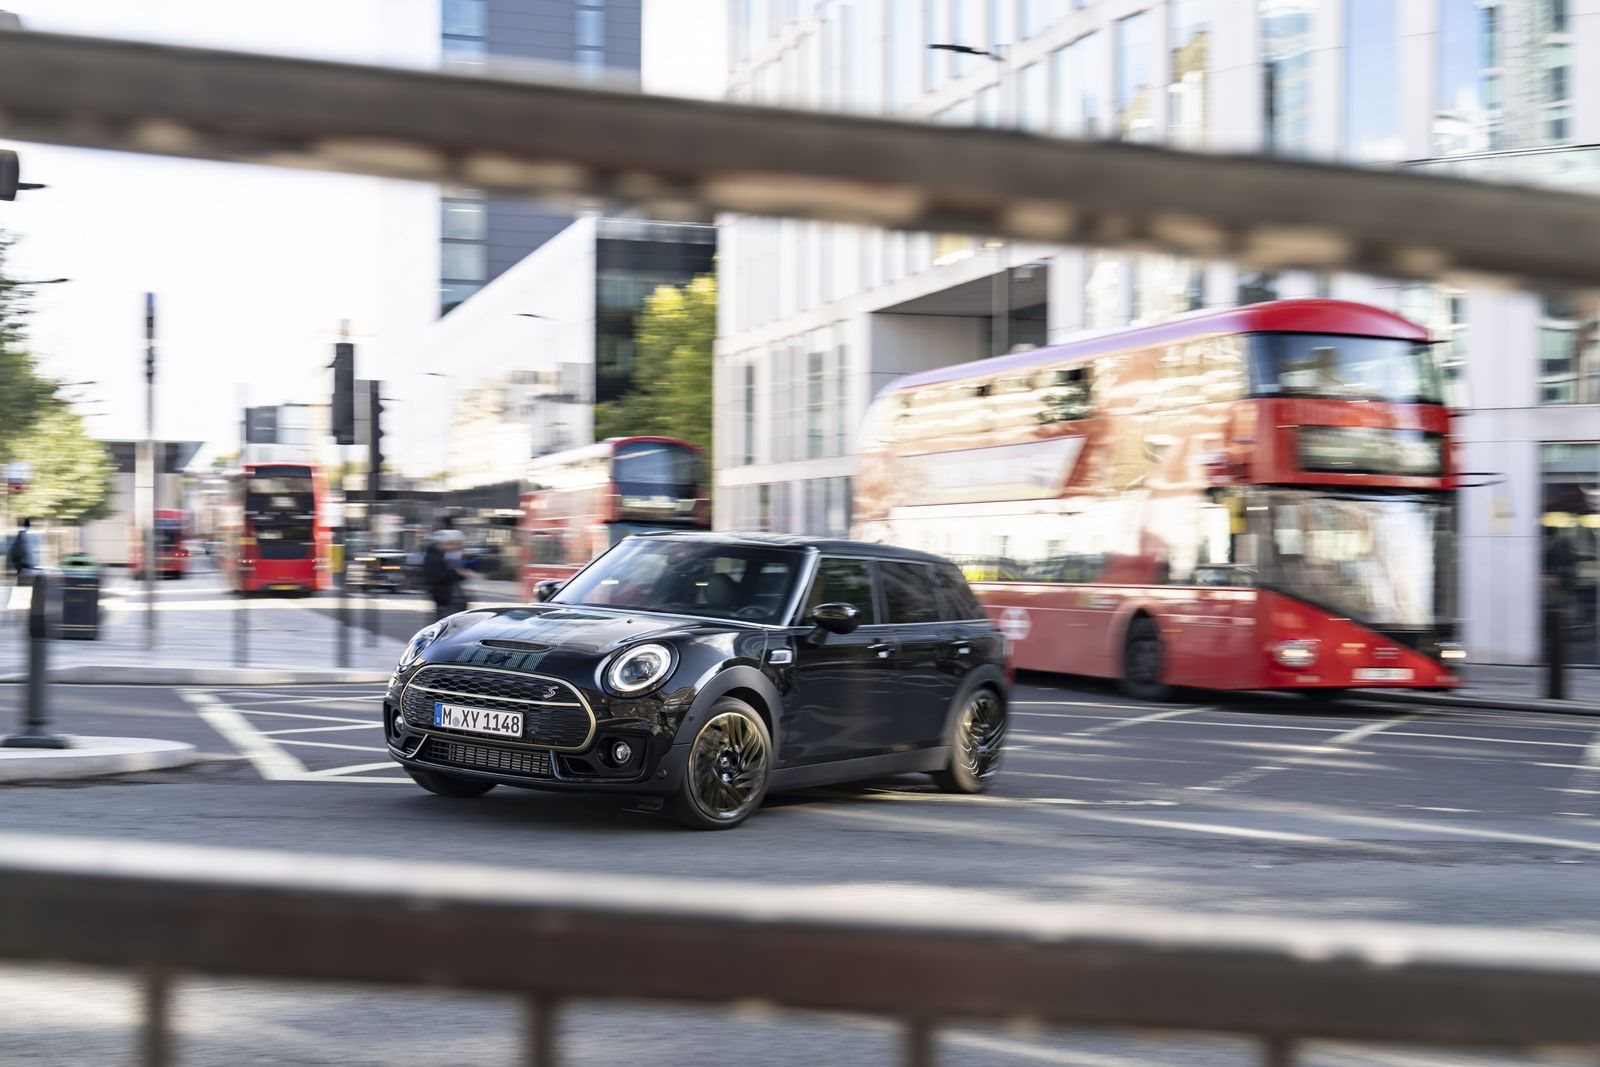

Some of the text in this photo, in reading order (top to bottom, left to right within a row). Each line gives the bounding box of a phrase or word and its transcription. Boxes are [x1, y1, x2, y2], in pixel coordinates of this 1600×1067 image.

[442, 707, 520, 734] M XY 1148
